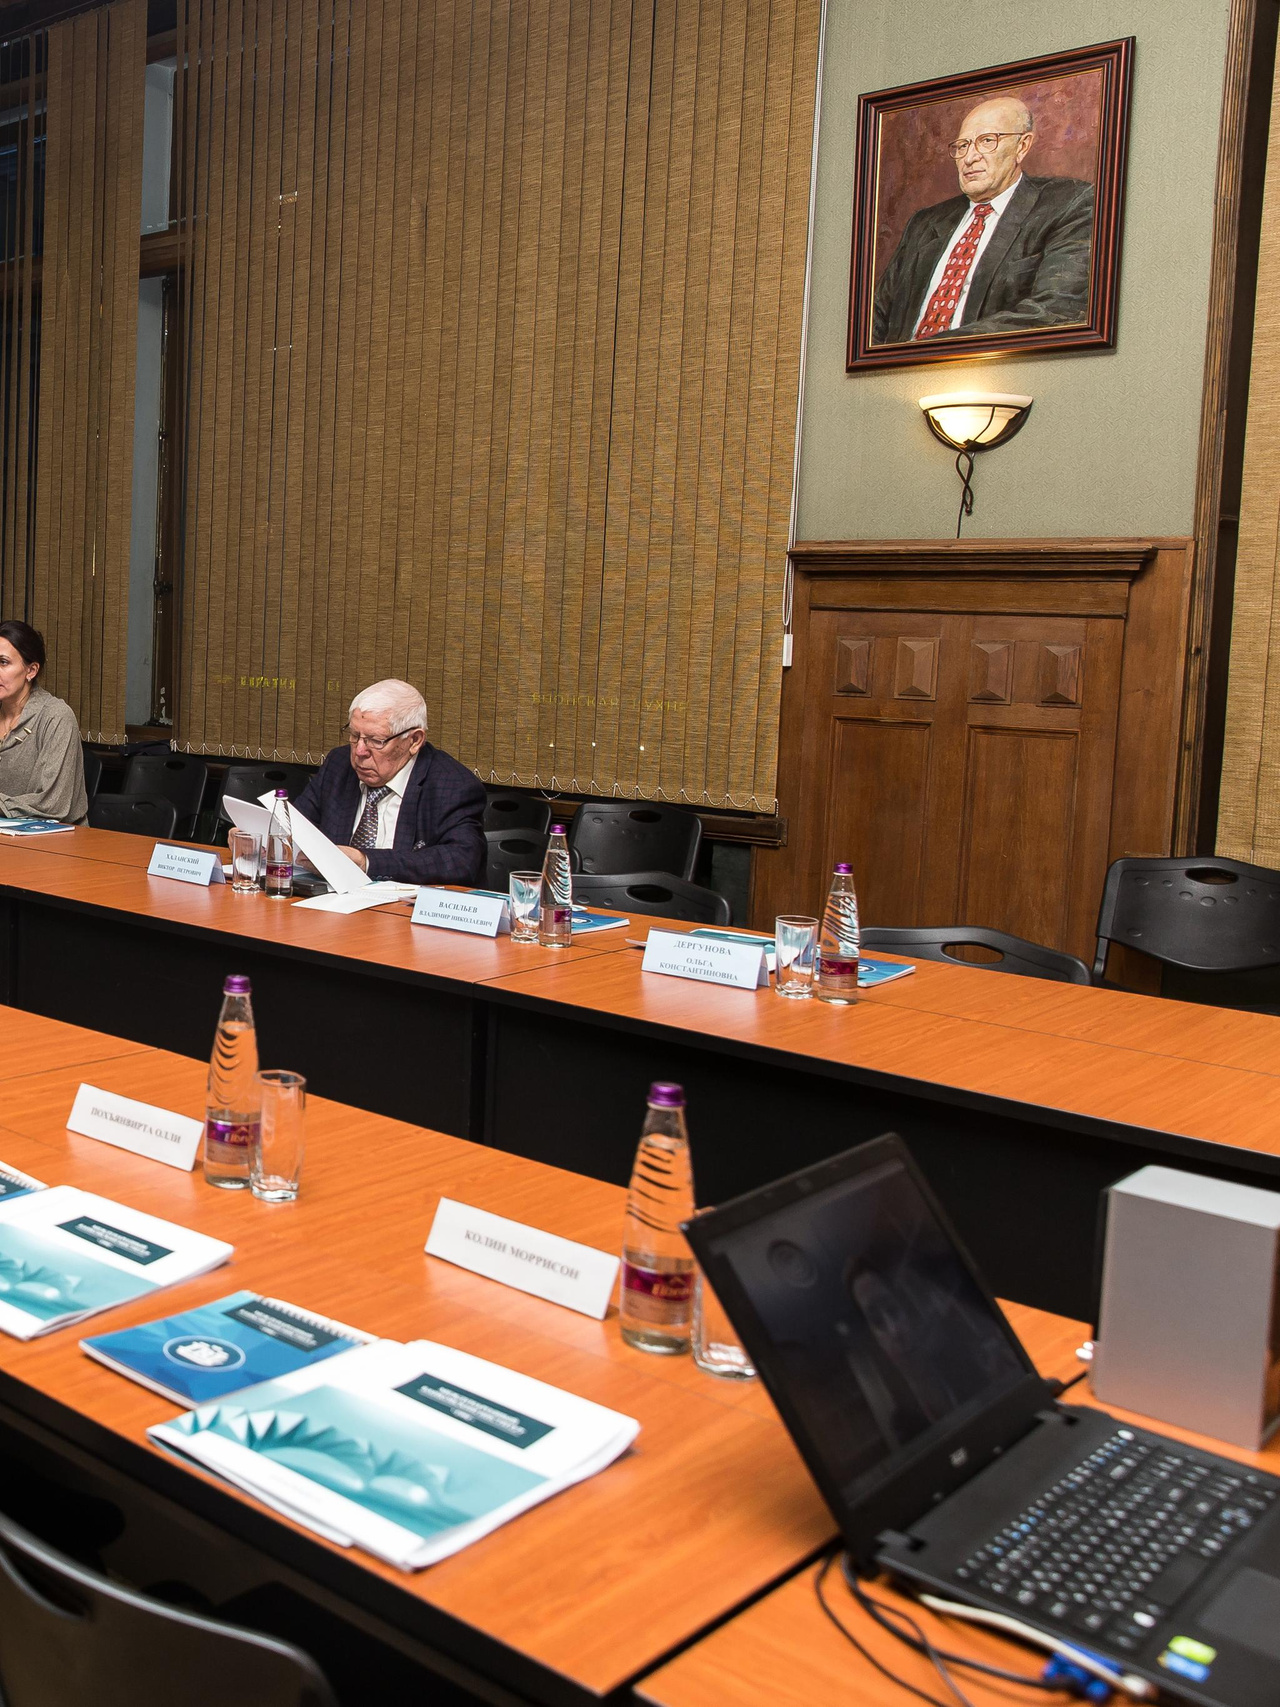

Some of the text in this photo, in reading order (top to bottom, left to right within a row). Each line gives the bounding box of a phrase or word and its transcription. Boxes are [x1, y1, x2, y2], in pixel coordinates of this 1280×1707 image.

[157, 863, 201, 877] ВИКТОР ПЕТРОВИЧ
[438, 901, 478, 914] ВАСИЛЬЕВ
[419, 910, 493, 927] ВЛАДИМИР НИКОЛАЕВИЧ
[673, 940, 732, 956] ДЕРГУНОВА
[686, 957, 713, 968] ОЛЬГА
[659, 961, 738, 981] КОНСТАНТИНОВНА
[154, 1128, 182, 1144] ОЛЛИ
[464, 1229, 580, 1280] КОЛИН МОРРИСОН
